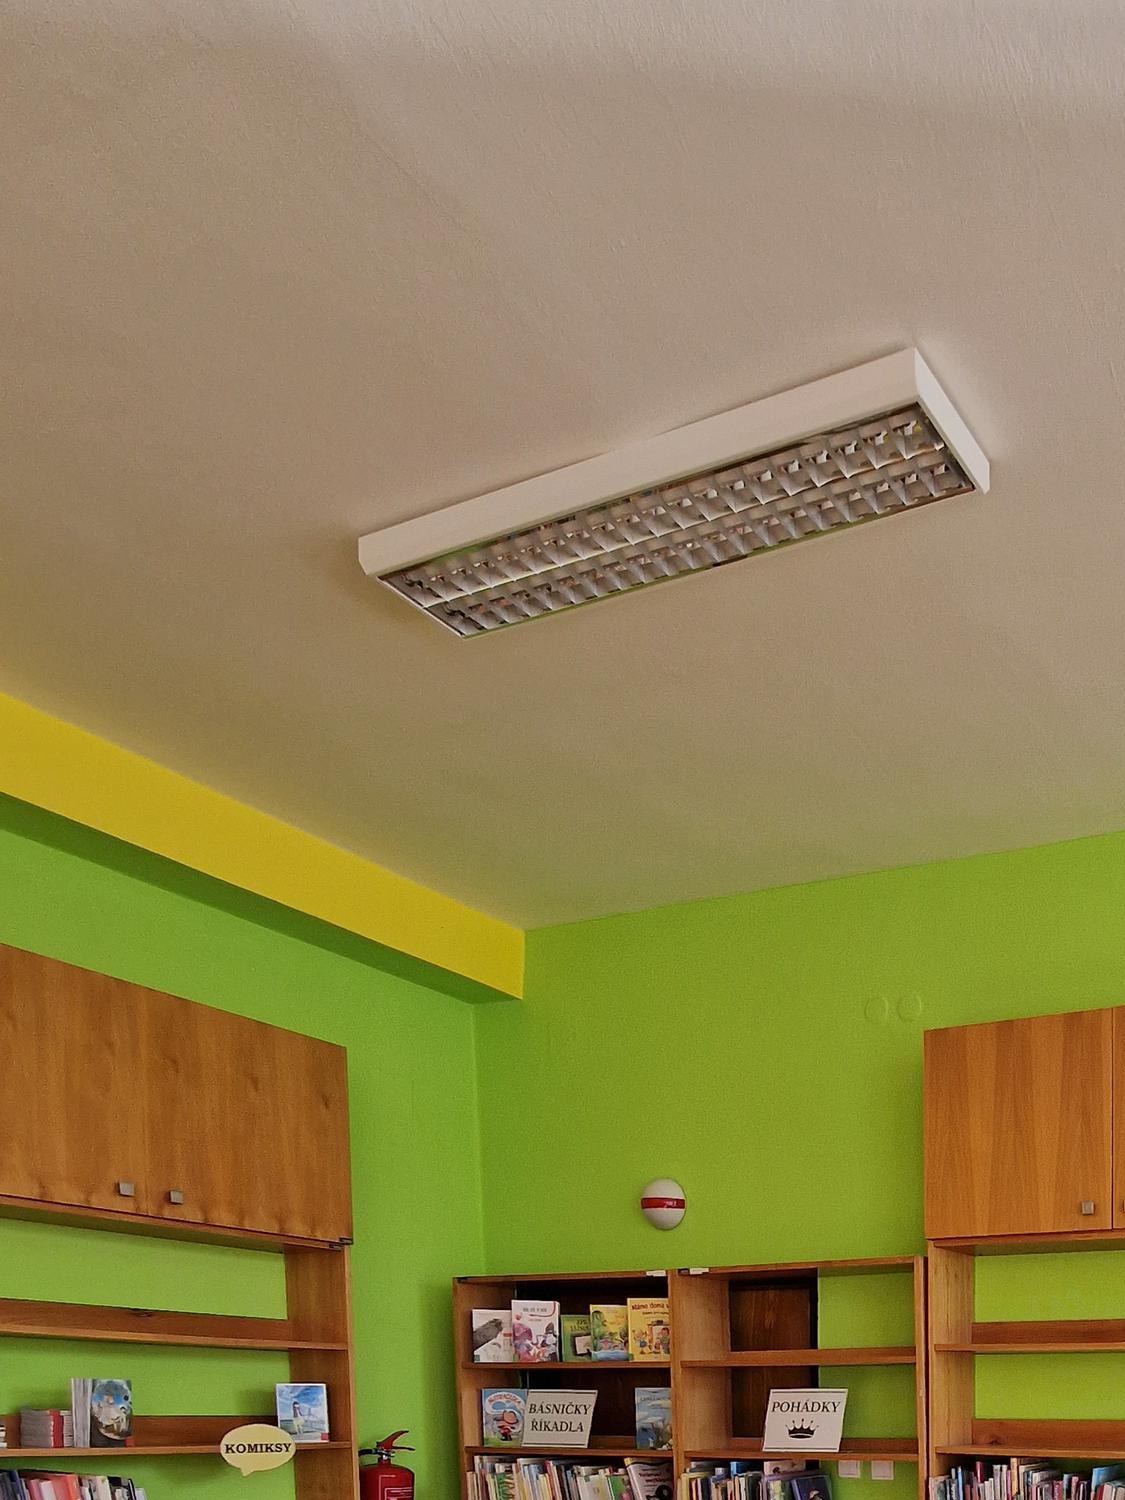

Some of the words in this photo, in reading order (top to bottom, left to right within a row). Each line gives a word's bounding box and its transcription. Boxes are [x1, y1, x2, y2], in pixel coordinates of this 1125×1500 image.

[529, 1401, 592, 1416] BÁSNIČKY
[771, 1399, 841, 1413] POHÁDKY
[530, 1418, 585, 1432] ŘÍKADLA
[224, 1443, 292, 1454] KOMIKSY
